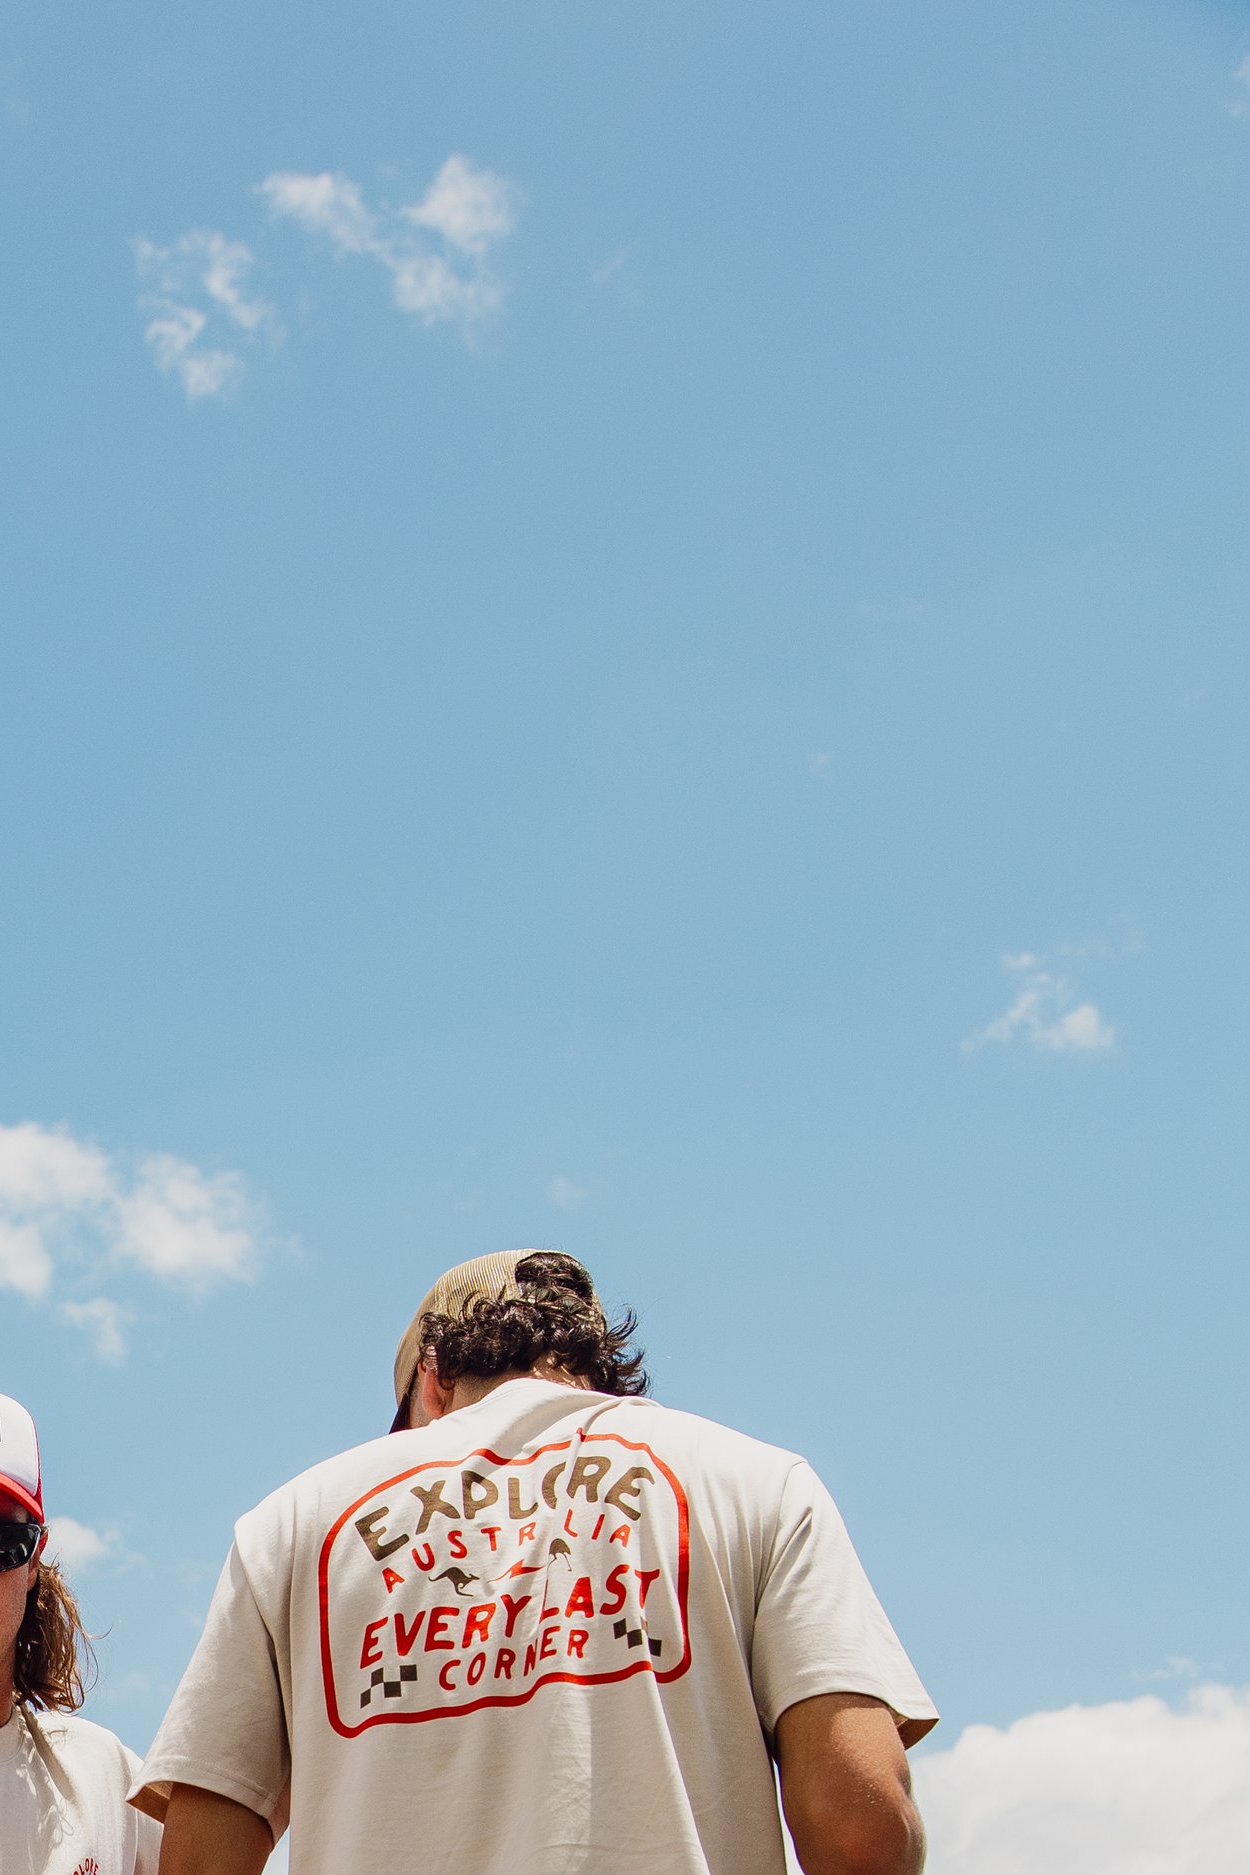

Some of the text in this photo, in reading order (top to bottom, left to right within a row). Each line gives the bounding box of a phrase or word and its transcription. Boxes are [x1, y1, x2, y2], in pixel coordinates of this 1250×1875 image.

[381, 1508, 632, 1594] AUSTRLIA
[359, 1593, 533, 1670] EVERY
[438, 1625, 590, 1691] CORNER
